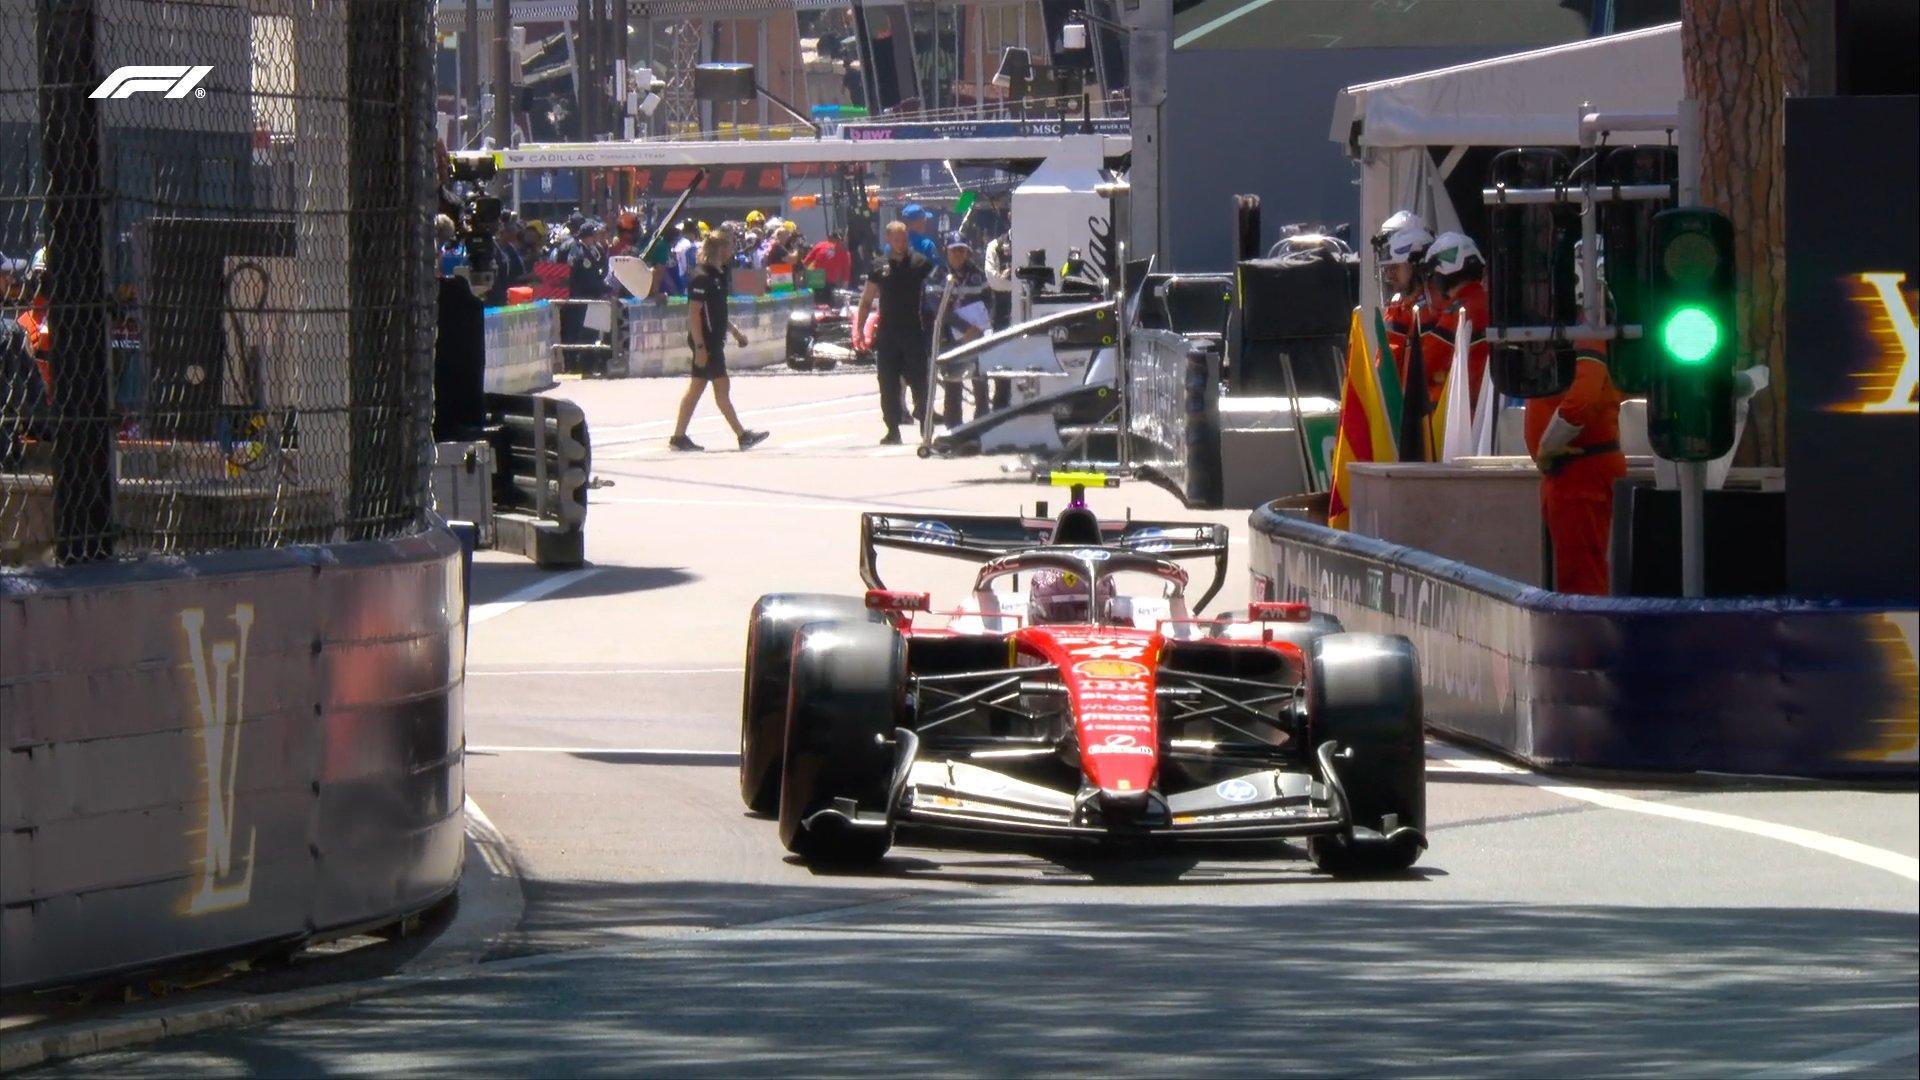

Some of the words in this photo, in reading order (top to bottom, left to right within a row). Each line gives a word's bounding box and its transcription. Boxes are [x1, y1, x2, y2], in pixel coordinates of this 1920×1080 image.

[1032, 124, 1061, 134] MSC
[529, 153, 595, 162] CADILLAC
[1079, 680, 1149, 692] IBM
